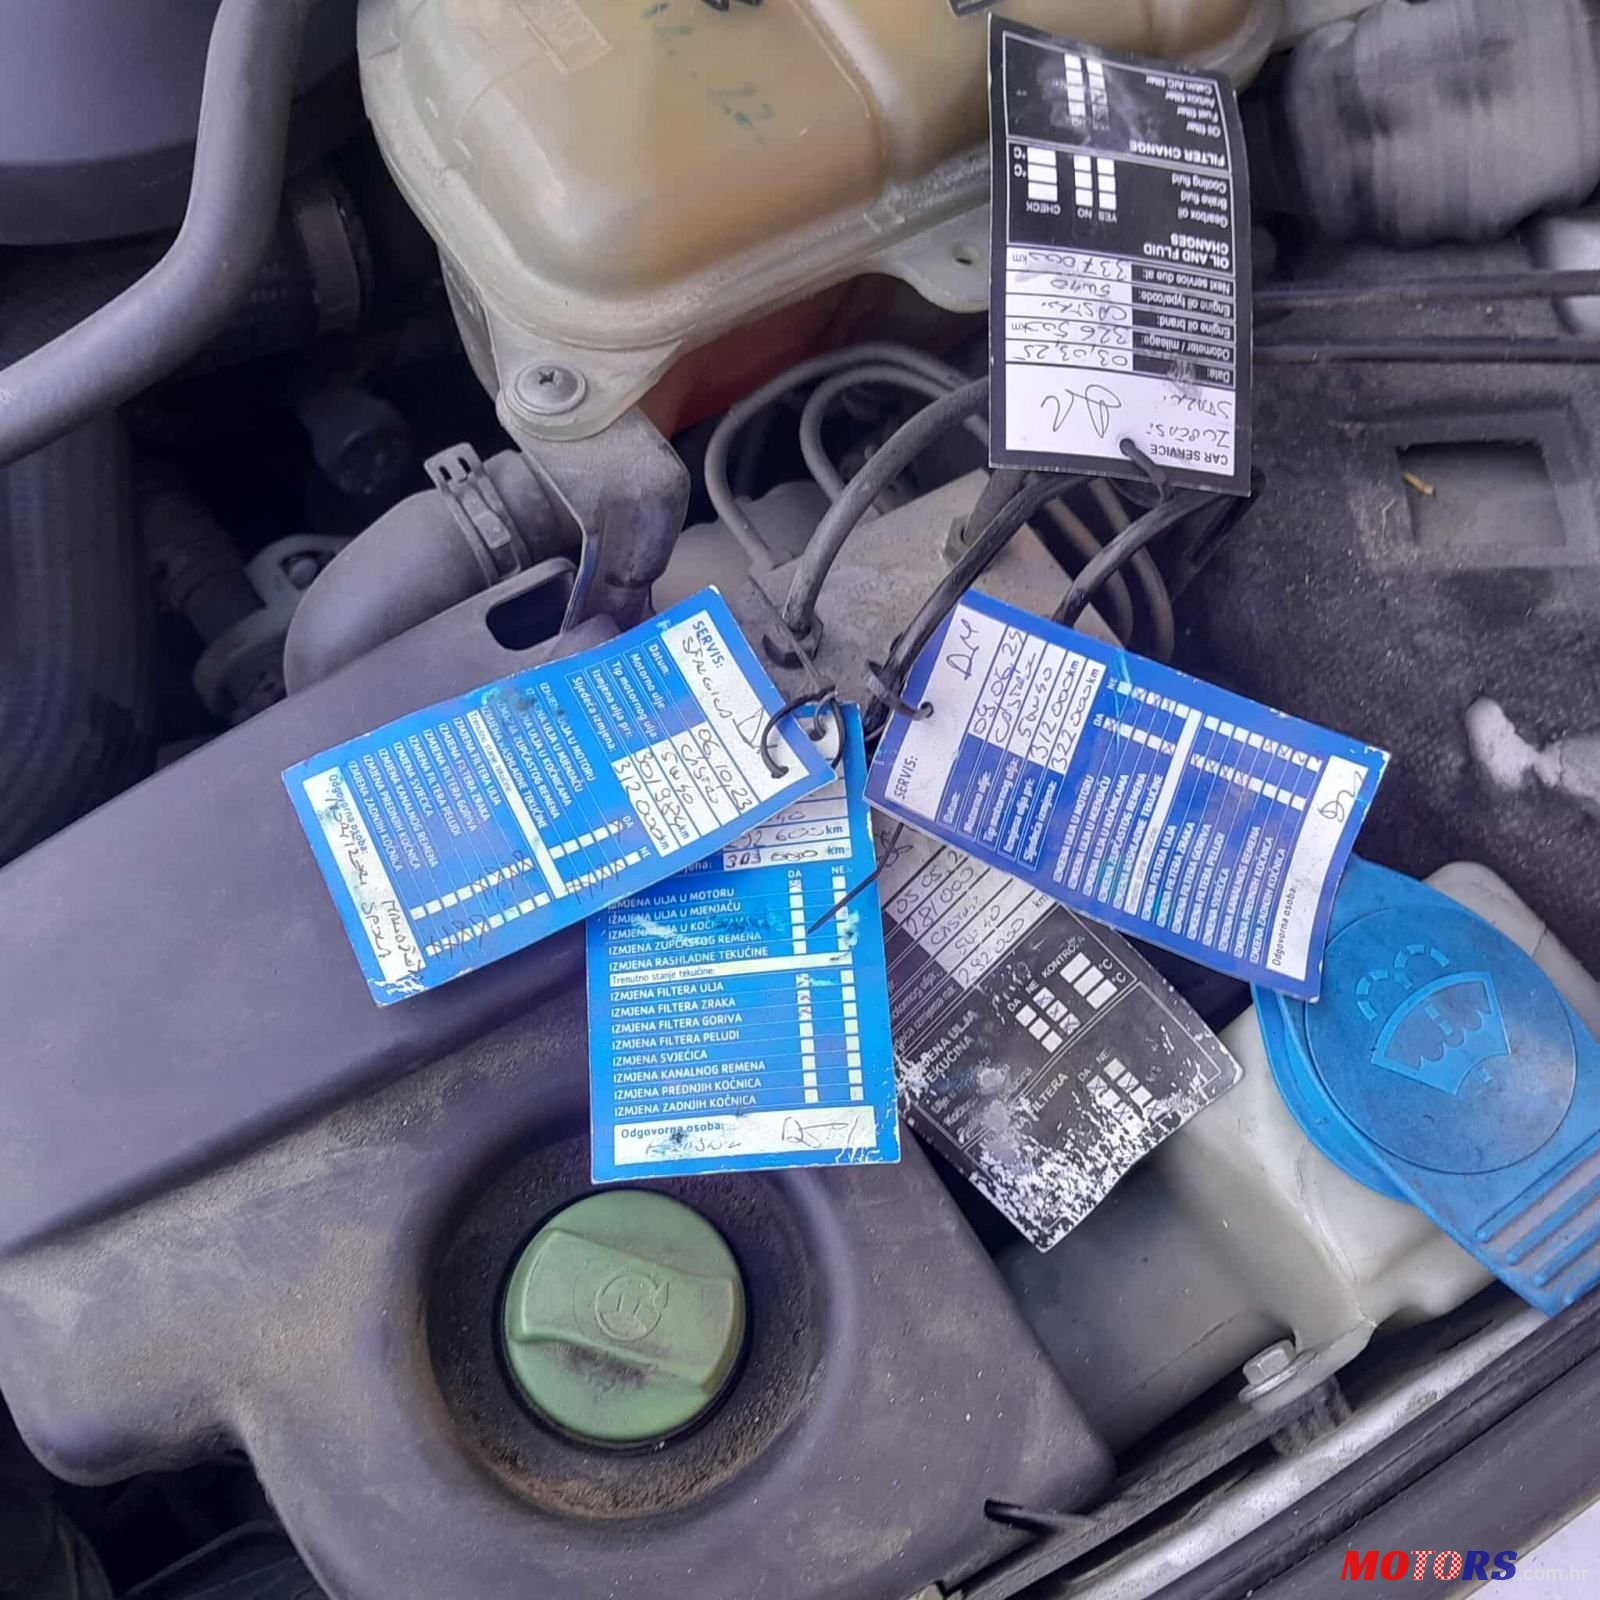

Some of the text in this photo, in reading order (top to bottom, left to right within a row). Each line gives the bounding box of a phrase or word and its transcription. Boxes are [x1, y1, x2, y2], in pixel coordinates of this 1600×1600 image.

[1128, 137, 1224, 166] FILTER CHANGE
[1026, 199, 1060, 215] CHECK
[1077, 207, 1091, 219] NO
[1143, 241, 1228, 268] OIL AND FLUID
[1170, 232, 1228, 254] CHANGES
[1156, 269, 1172, 284] due
[1174, 273, 1207, 291] service
[1209, 280, 1230, 296] Next
[1187, 295, 1197, 310] oil
[1200, 298, 1229, 316] Engine
[1156, 312, 1229, 338] Engine oil brand:
[1187, 340, 1229, 359] Odometer
[1206, 367, 1230, 382] Date:
[1149, 443, 1227, 465] CAR SERVICE
[690, 620, 727, 668] SERVIS:
[647, 644, 673, 676] Datum:
[1066, 659, 1080, 676] km
[628, 653, 669, 712] Motorno ulje:
[1087, 667, 1099, 684] km
[1106, 676, 1118, 690] NE
[589, 668, 637, 738] Izmjena ulja pri:
[608, 661, 661, 741] Tip motornog ulja:
[479, 705, 504, 741] IZMJENA
[569, 676, 619, 753] Sljedeća izmjena:
[391, 741, 416, 778] IZMJENA
[451, 716, 503, 806] IZMJENA FILTERA ULJA
[526, 728, 574, 807] ULJA KOČNICAMA
[540, 721, 585, 793] ULJA MJENJAČU
[570, 744, 597, 781] MOTORU
[422, 728, 479, 832] IZMJENA FILTERA GORIVA
[436, 722, 492, 821] IZMJENA FILTERA ZRAKA
[512, 734, 544, 785] ZUPČASTOG
[536, 783, 562, 819] REMENA
[892, 752, 918, 799] SERVIS:
[346, 759, 370, 797] IZMJENA
[362, 796, 387, 834] ZADNJIH
[362, 753, 386, 790] IZMJENA
[378, 789, 405, 832] PREDNJIH
[407, 734, 463, 836] IZMJENA FILTERA PELUDI
[326, 772, 356, 824] Odgovorna
[348, 822, 370, 856] osoba:
[377, 747, 440, 868] IZMJENA KANALNOG REMENA
[621, 815, 651, 859] DA NE
[825, 825, 842, 833] km
[787, 866, 844, 878] DA NE
[653, 888, 734, 904] ULJA MOTORU
[654, 909, 676, 919] ULJA
[689, 900, 740, 916] MJENJAČU
[609, 931, 760, 955] IZMJENA REMENA
[1271, 916, 1293, 967] Odgovorna
[609, 945, 768, 970] IZMJENA RASHLADNE TEKUĆINE
[612, 972, 648, 984] Trenutno
[651, 969, 676, 982] stanje
[610, 982, 723, 1001] IZMJENA FILTERA ULJA
[1005, 978, 1039, 1012] DA NE
[611, 998, 735, 1017] IZMJENA FILTERA ZRAKA
[612, 1014, 742, 1033] IZMJENA FILTERA GORIVA
[946, 1008, 979, 1040] ULJA
[613, 1031, 739, 1049] IZMJENA FILTERA PELUDI
[613, 1048, 707, 1066] IZMJENA SVJEĆICA
[614, 1061, 765, 1082] IZMJENA KANALNOG REMENA
[614, 1075, 760, 1099] IZMJENA PREDNJIH KOČNICA
[615, 1092, 756, 1116] IZMJENA ZADNJIH KOČNICA
[621, 1120, 724, 1139] Odgovorna osoba:
